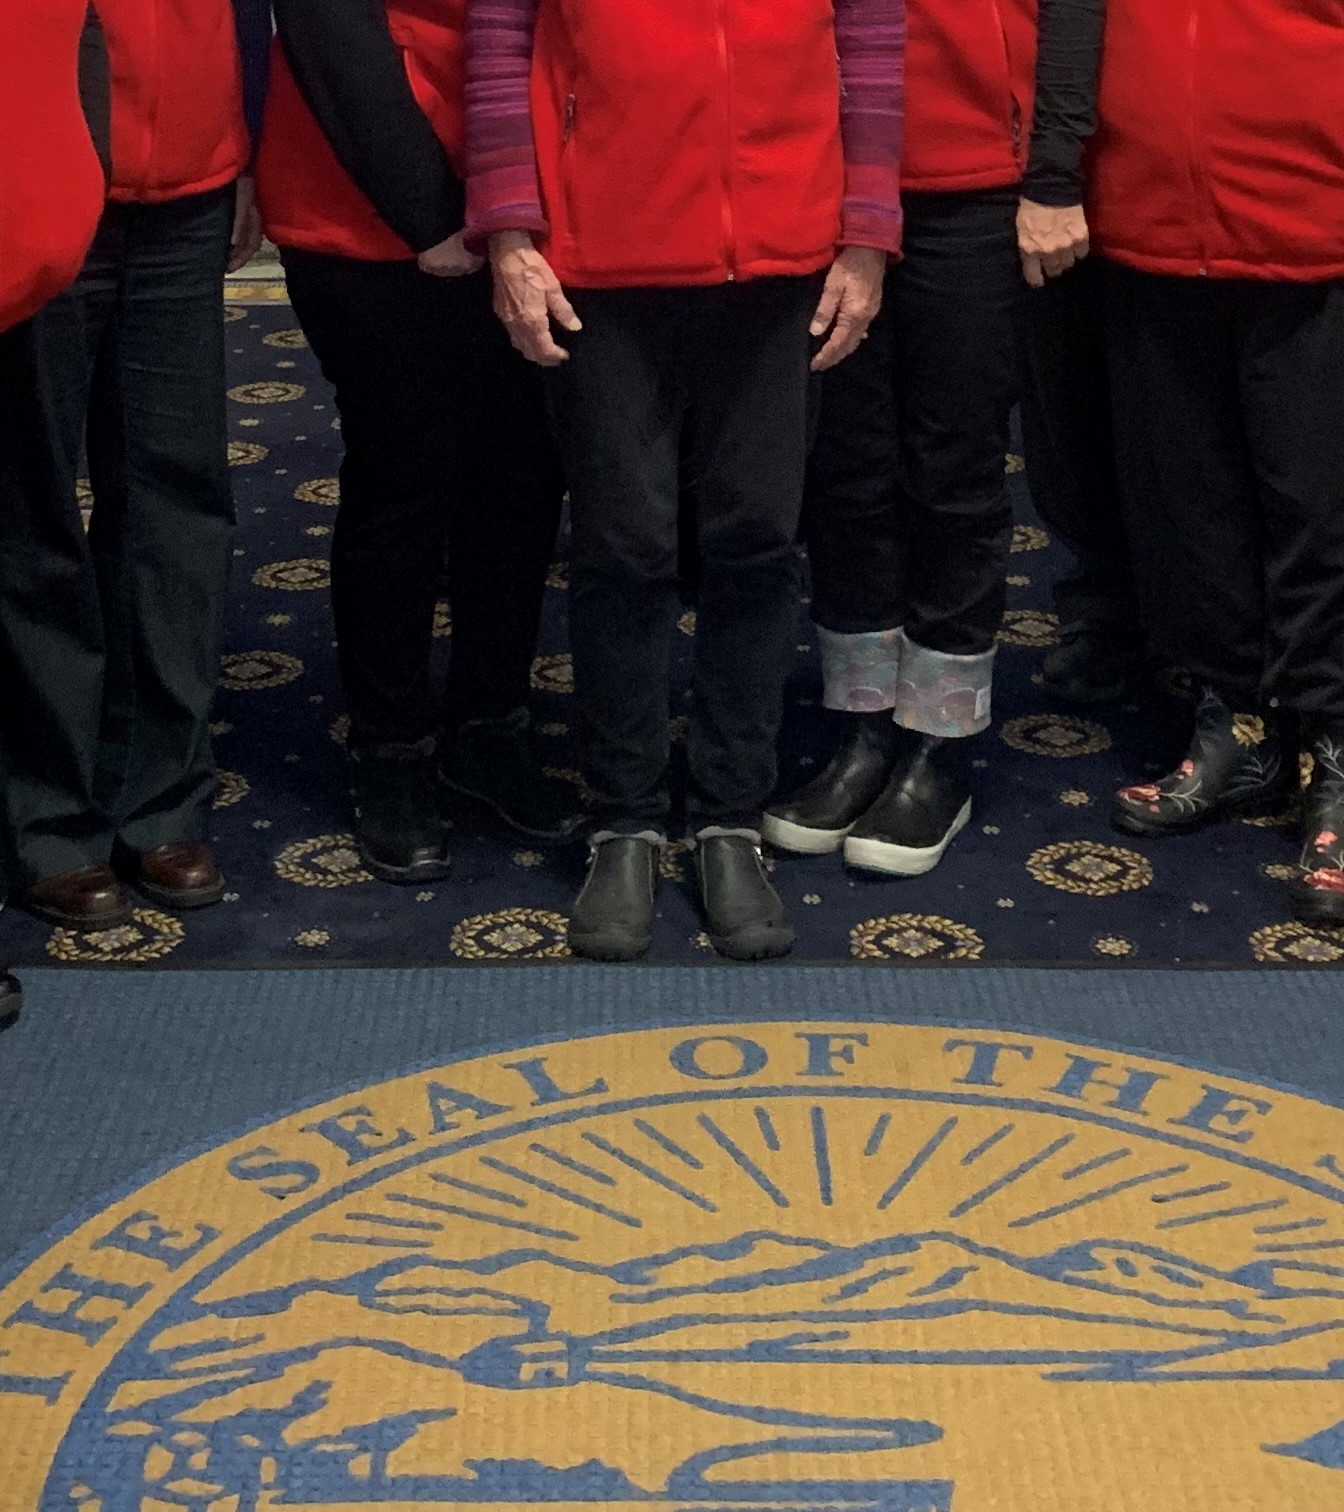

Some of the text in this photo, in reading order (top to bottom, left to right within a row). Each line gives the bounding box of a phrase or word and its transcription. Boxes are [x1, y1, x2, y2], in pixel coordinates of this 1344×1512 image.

[225, 1054, 609, 1202] SEAL
[666, 1030, 872, 1083] OF
[942, 1037, 1273, 1147] THE
